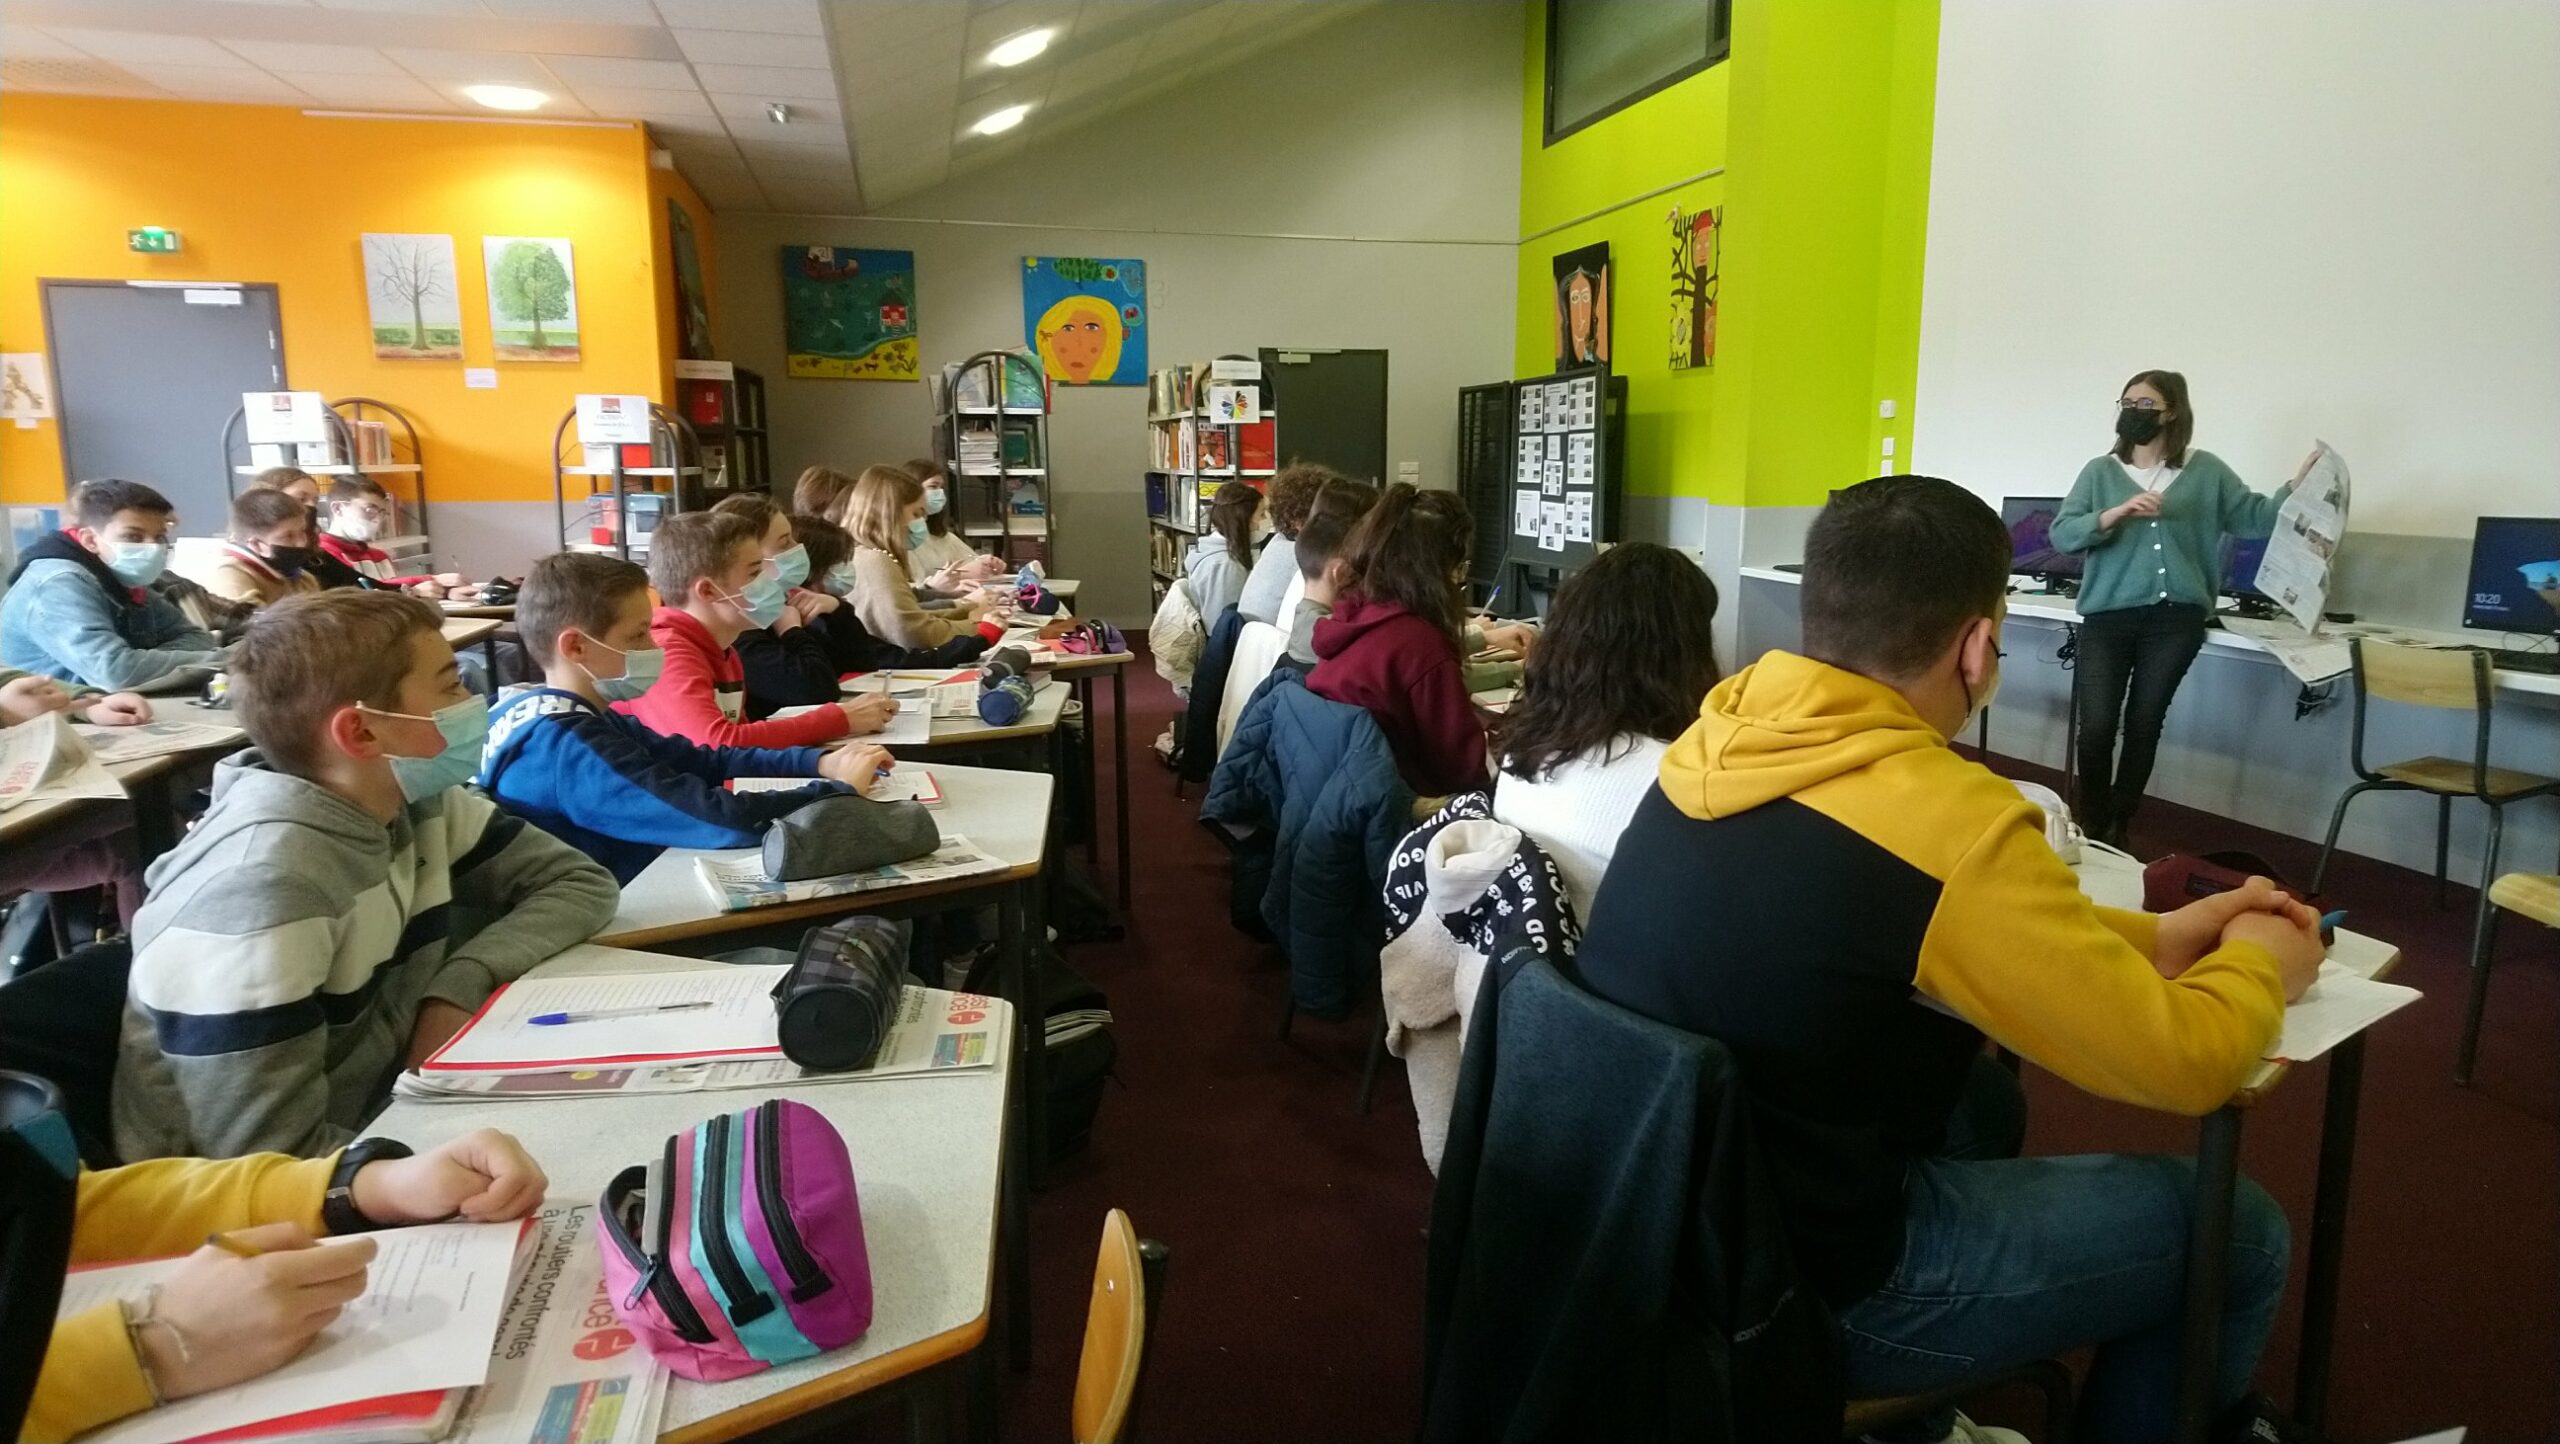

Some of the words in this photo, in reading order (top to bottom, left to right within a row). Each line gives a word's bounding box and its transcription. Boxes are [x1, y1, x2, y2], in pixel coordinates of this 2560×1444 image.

[2474, 593, 2501, 604] 10:20
[565, 1204, 593, 1230] Les
[542, 1230, 577, 1282] routiers
[505, 1281, 556, 1360] confrontés
